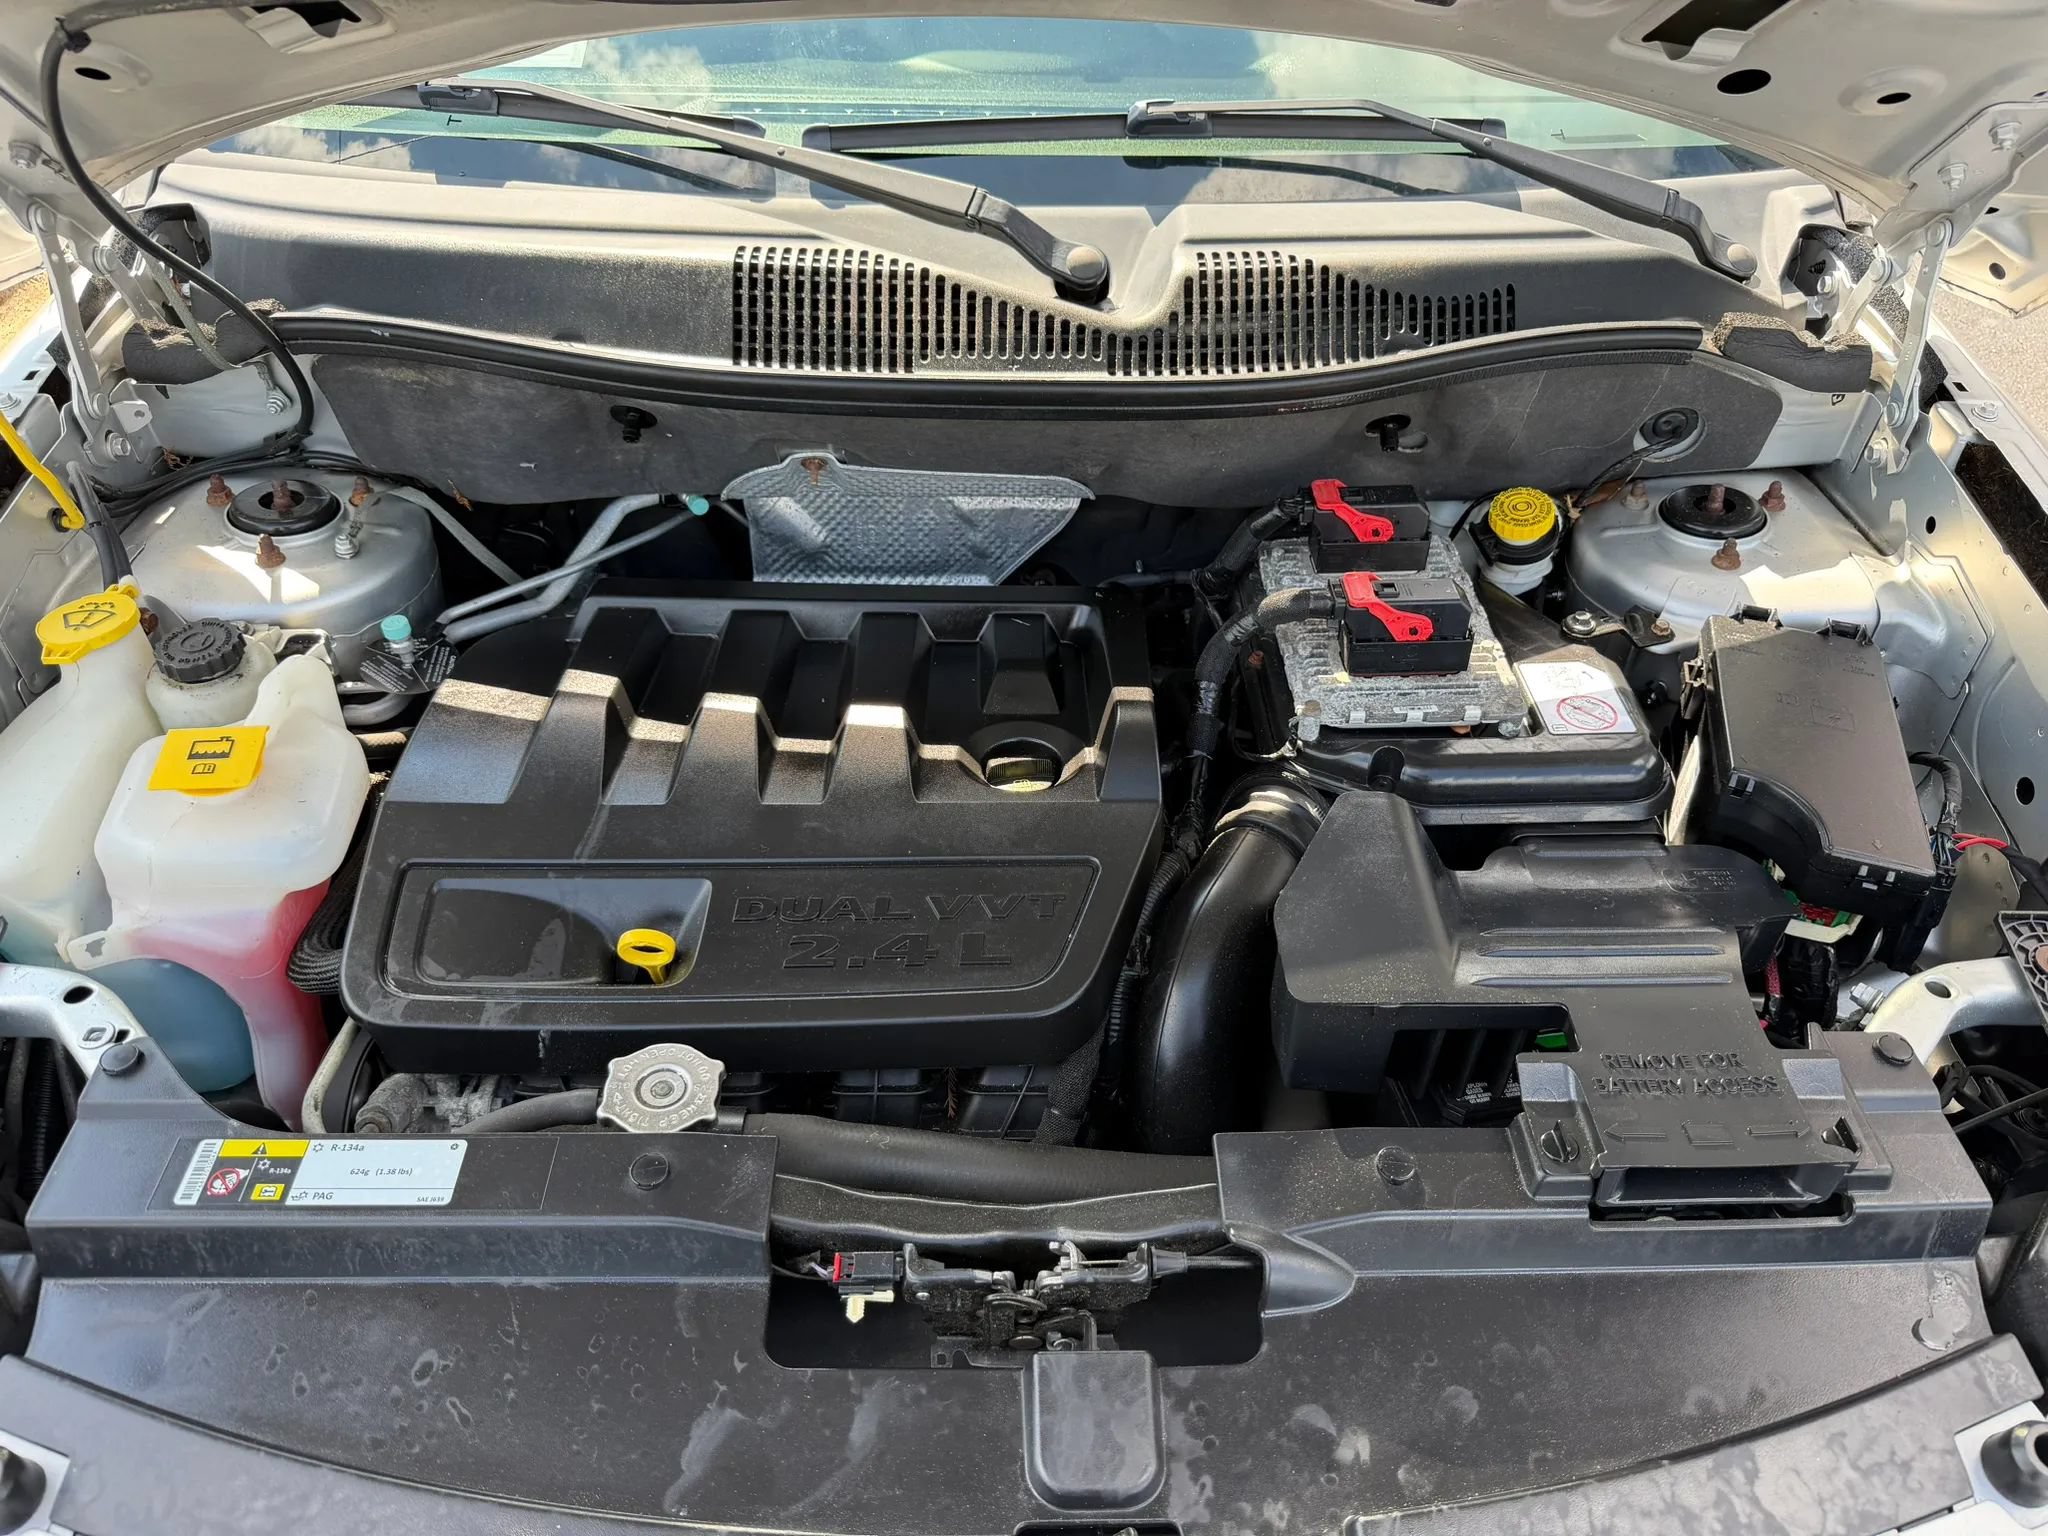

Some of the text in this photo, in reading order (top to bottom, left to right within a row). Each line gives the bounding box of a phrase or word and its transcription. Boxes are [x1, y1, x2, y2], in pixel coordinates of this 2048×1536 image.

[732, 894, 1067, 922] DUAL VVT
[783, 932, 1012, 969] 2.4 L
[1600, 1051, 1747, 1070] REMOVE FOR
[1593, 1075, 1783, 1096] BATTERY ACCESS
[659, 1103, 698, 1127] KEEP
[330, 1143, 365, 1152] R-134a
[269, 1167, 292, 1175] R-134a
[350, 1168, 413, 1177] 624g (1.38 lbs)
[312, 1192, 333, 1200] PAG
